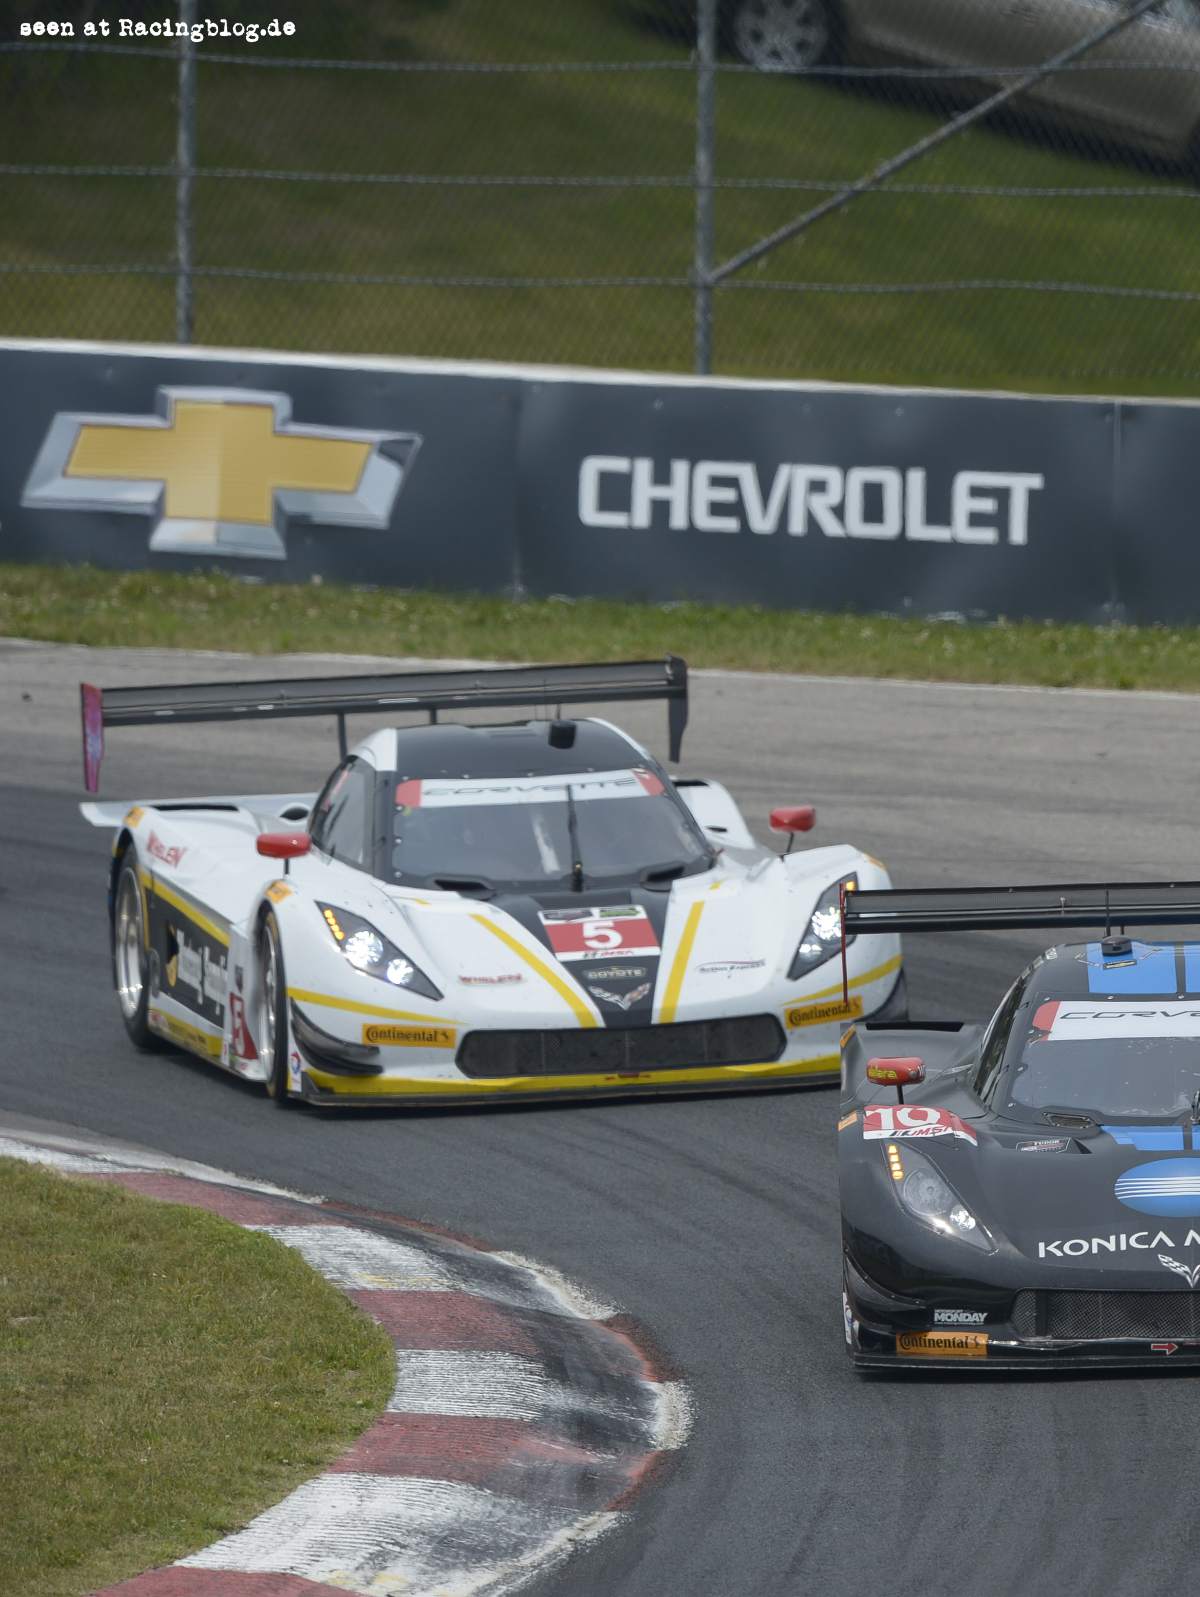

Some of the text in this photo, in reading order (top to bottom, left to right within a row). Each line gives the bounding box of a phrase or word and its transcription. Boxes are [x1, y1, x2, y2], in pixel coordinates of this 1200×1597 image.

[578, 454, 1044, 546] CHEVROLET
[583, 921, 623, 950] 5
[789, 1005, 852, 1025] Continental
[366, 1025, 438, 1043] Continental
[865, 1107, 941, 1130] 10
[1038, 1230, 1176, 1258] KONICA
[933, 1312, 988, 1322] MONDAY
[900, 1333, 969, 1350] Continental
